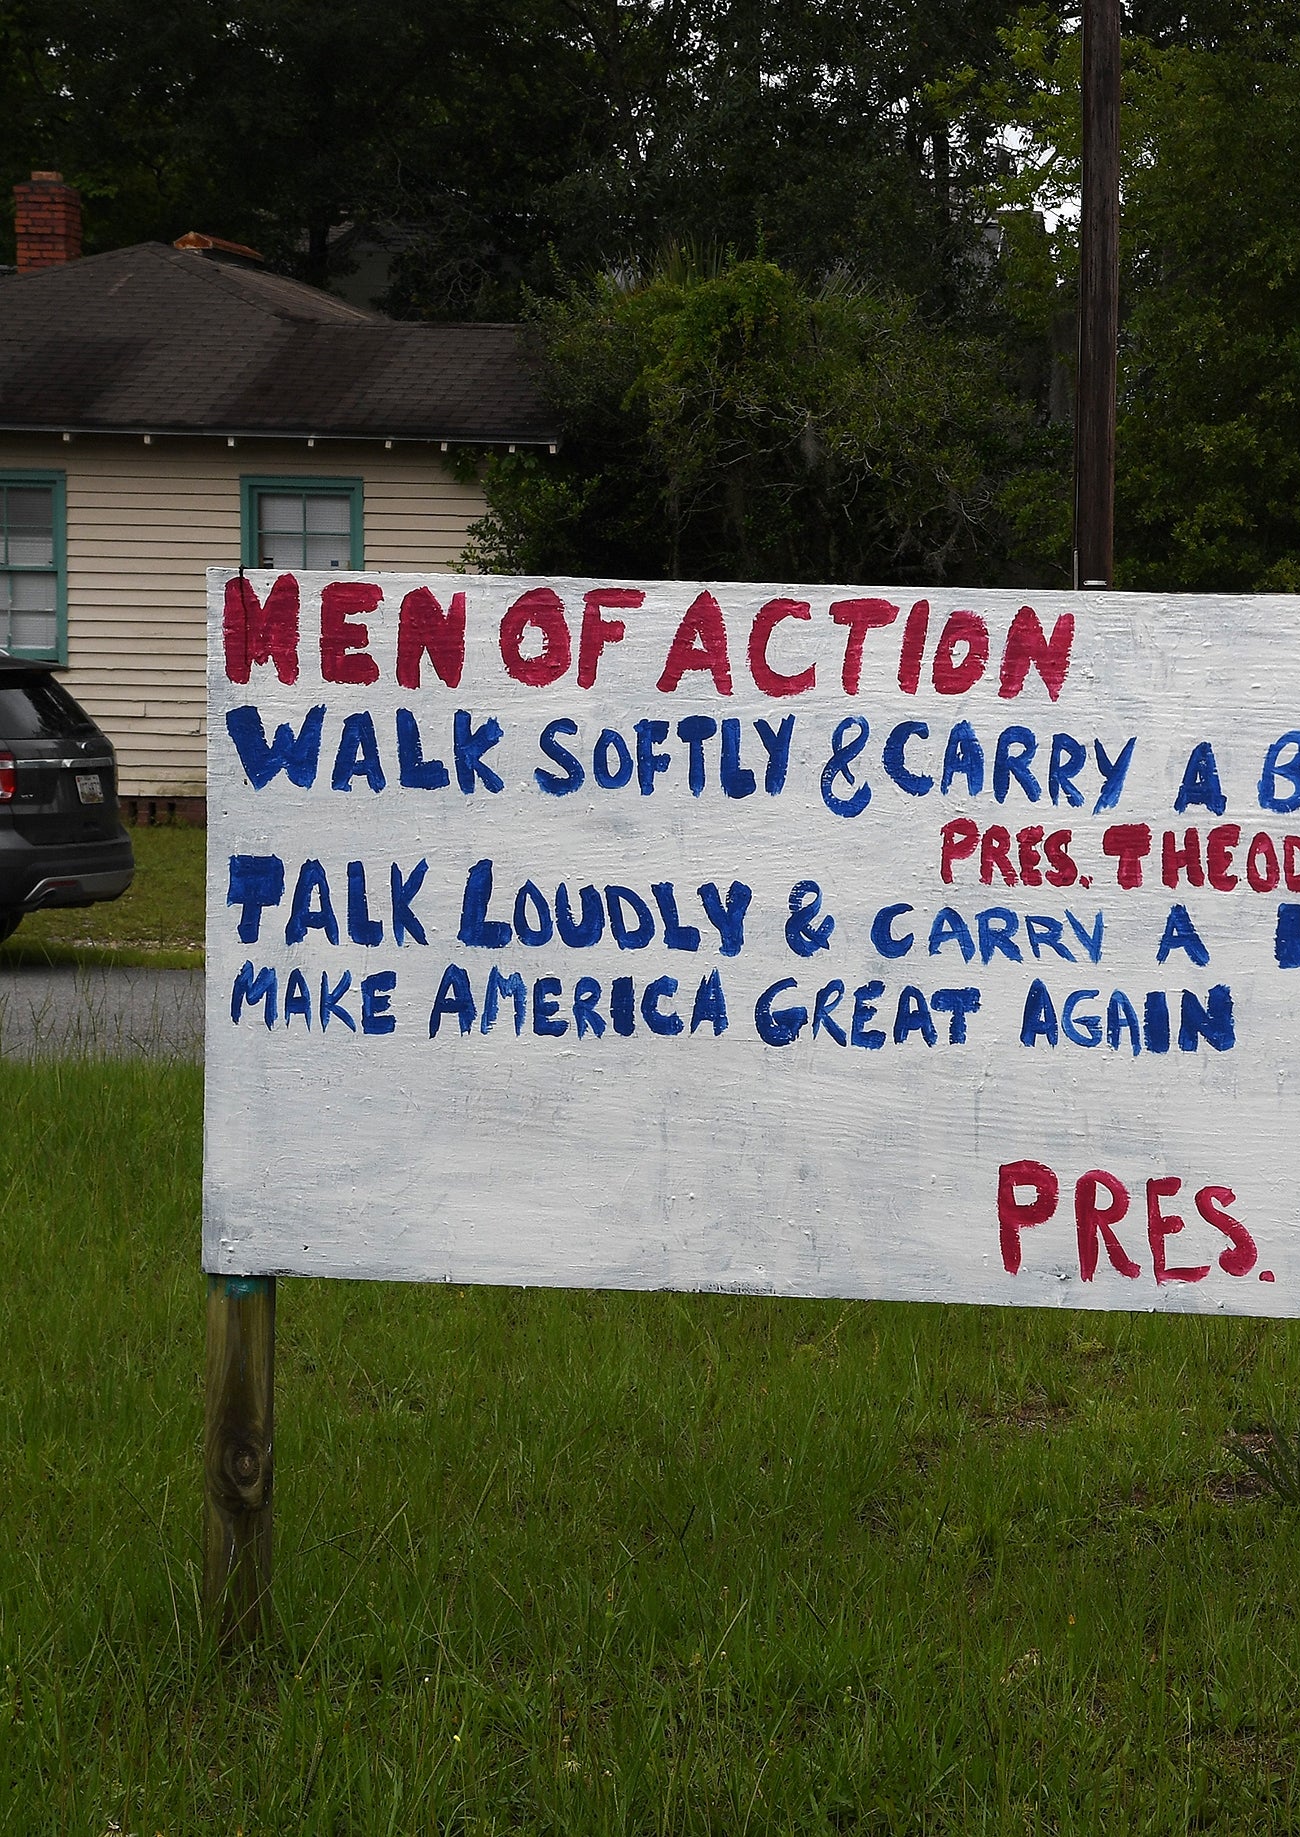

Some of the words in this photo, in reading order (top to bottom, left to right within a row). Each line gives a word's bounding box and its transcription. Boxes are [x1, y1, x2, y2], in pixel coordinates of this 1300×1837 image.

[222, 573, 467, 689] MEN
[499, 587, 646, 690] OF
[656, 590, 1075, 702] ACTION
[226, 704, 505, 795] WALK
[533, 715, 796, 799] SOFTLY
[821, 715, 873, 819] &
[882, 719, 1137, 815] CARRY
[1175, 742, 1226, 815] A
[940, 817, 1093, 889] PRES.
[226, 854, 430, 948] TALK
[456, 858, 752, 959] LOUDLY
[786, 879, 836, 959] &
[869, 902, 1106, 966] CARRY
[1156, 905, 1210, 968] A
[231, 960, 396, 1036] MAKE
[428, 963, 729, 1039] AMERICA
[755, 977, 981, 1051] GREAT
[1020, 977, 1237, 1057] AGAIN
[997, 1159, 1276, 1286] PRES.
